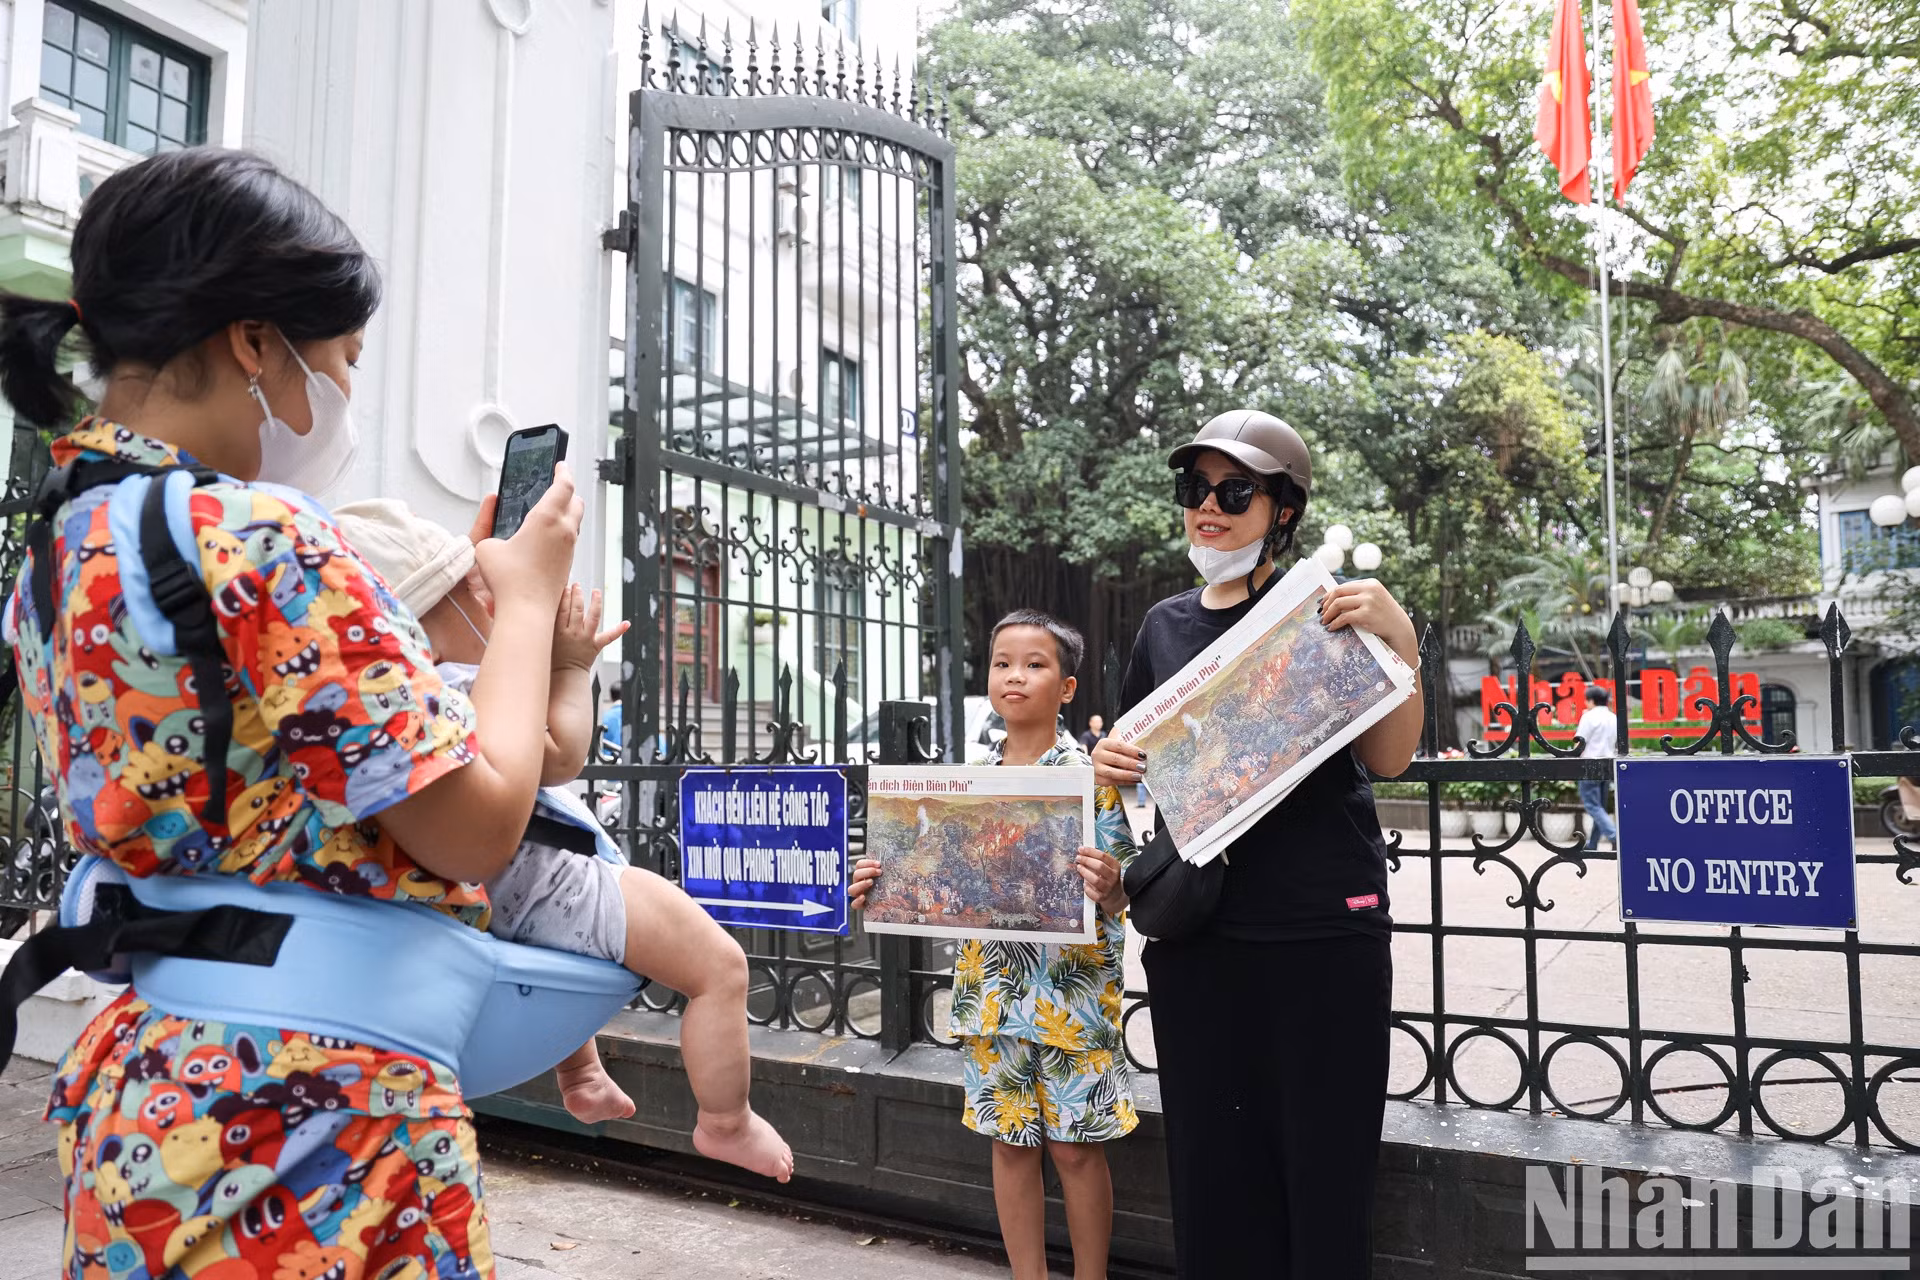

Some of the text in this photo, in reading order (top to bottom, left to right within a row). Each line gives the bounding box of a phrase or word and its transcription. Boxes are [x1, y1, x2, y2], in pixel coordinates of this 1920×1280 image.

[1640, 666, 1762, 723] Dân
[694, 779, 830, 831] KHÁCH ĐẾN LIÊN HỆ CÔNG TÁC
[880, 779, 900, 792] dịch
[902, 779, 924, 793] Điện
[926, 780, 947, 791] Biên
[1670, 788, 1793, 825] OFFICE
[687, 838, 840, 894] XIN MỜI QUA PHÒNG THƯỜNG TRỰC
[1647, 858, 1824, 897] NO ENTRY
